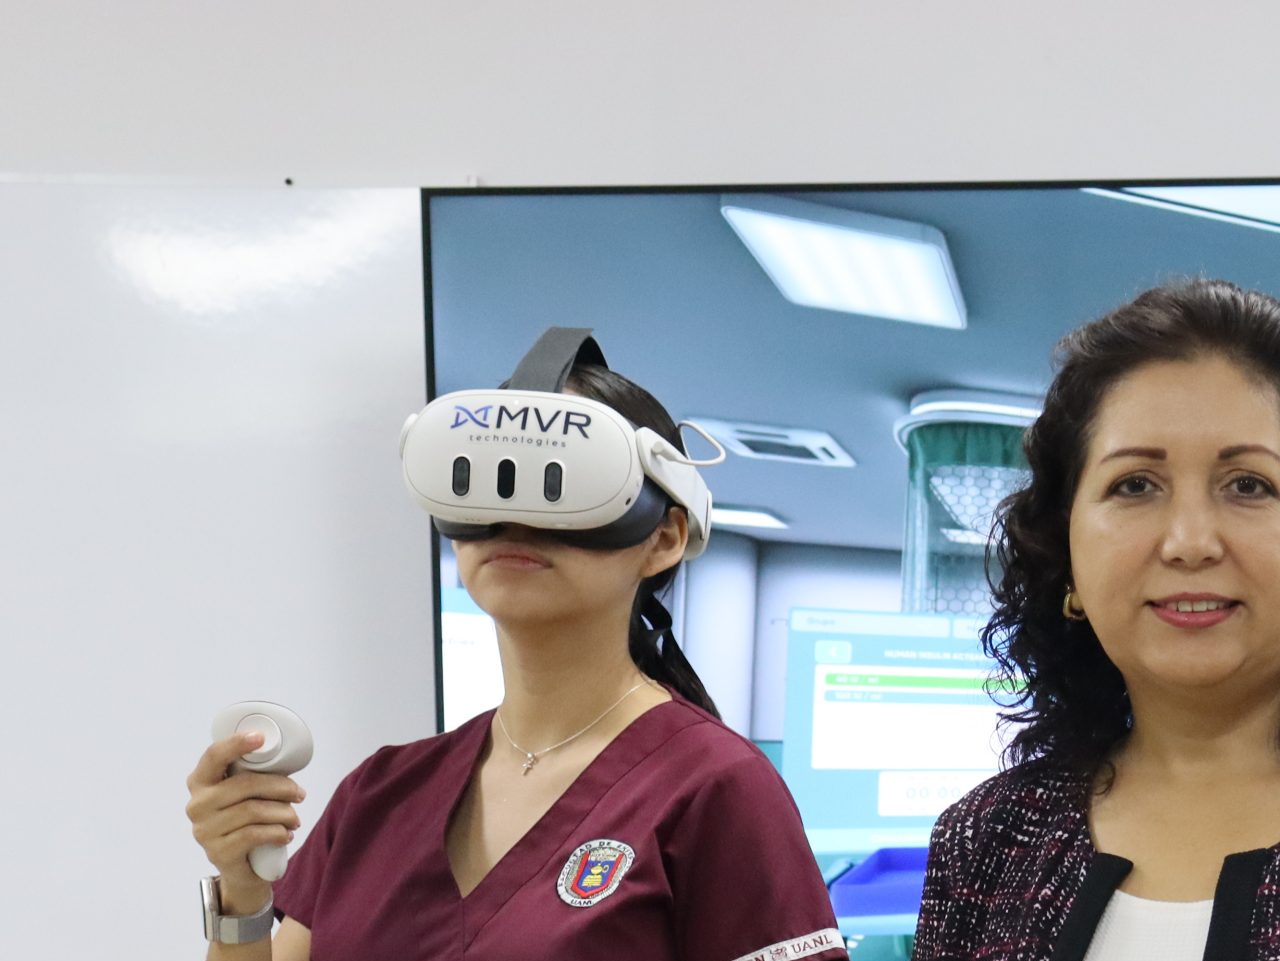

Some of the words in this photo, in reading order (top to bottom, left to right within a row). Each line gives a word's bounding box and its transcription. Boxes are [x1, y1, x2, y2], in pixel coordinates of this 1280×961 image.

[495, 405, 592, 439] MVR
[468, 433, 567, 447] technologies
[791, 934, 833, 954] UANL
